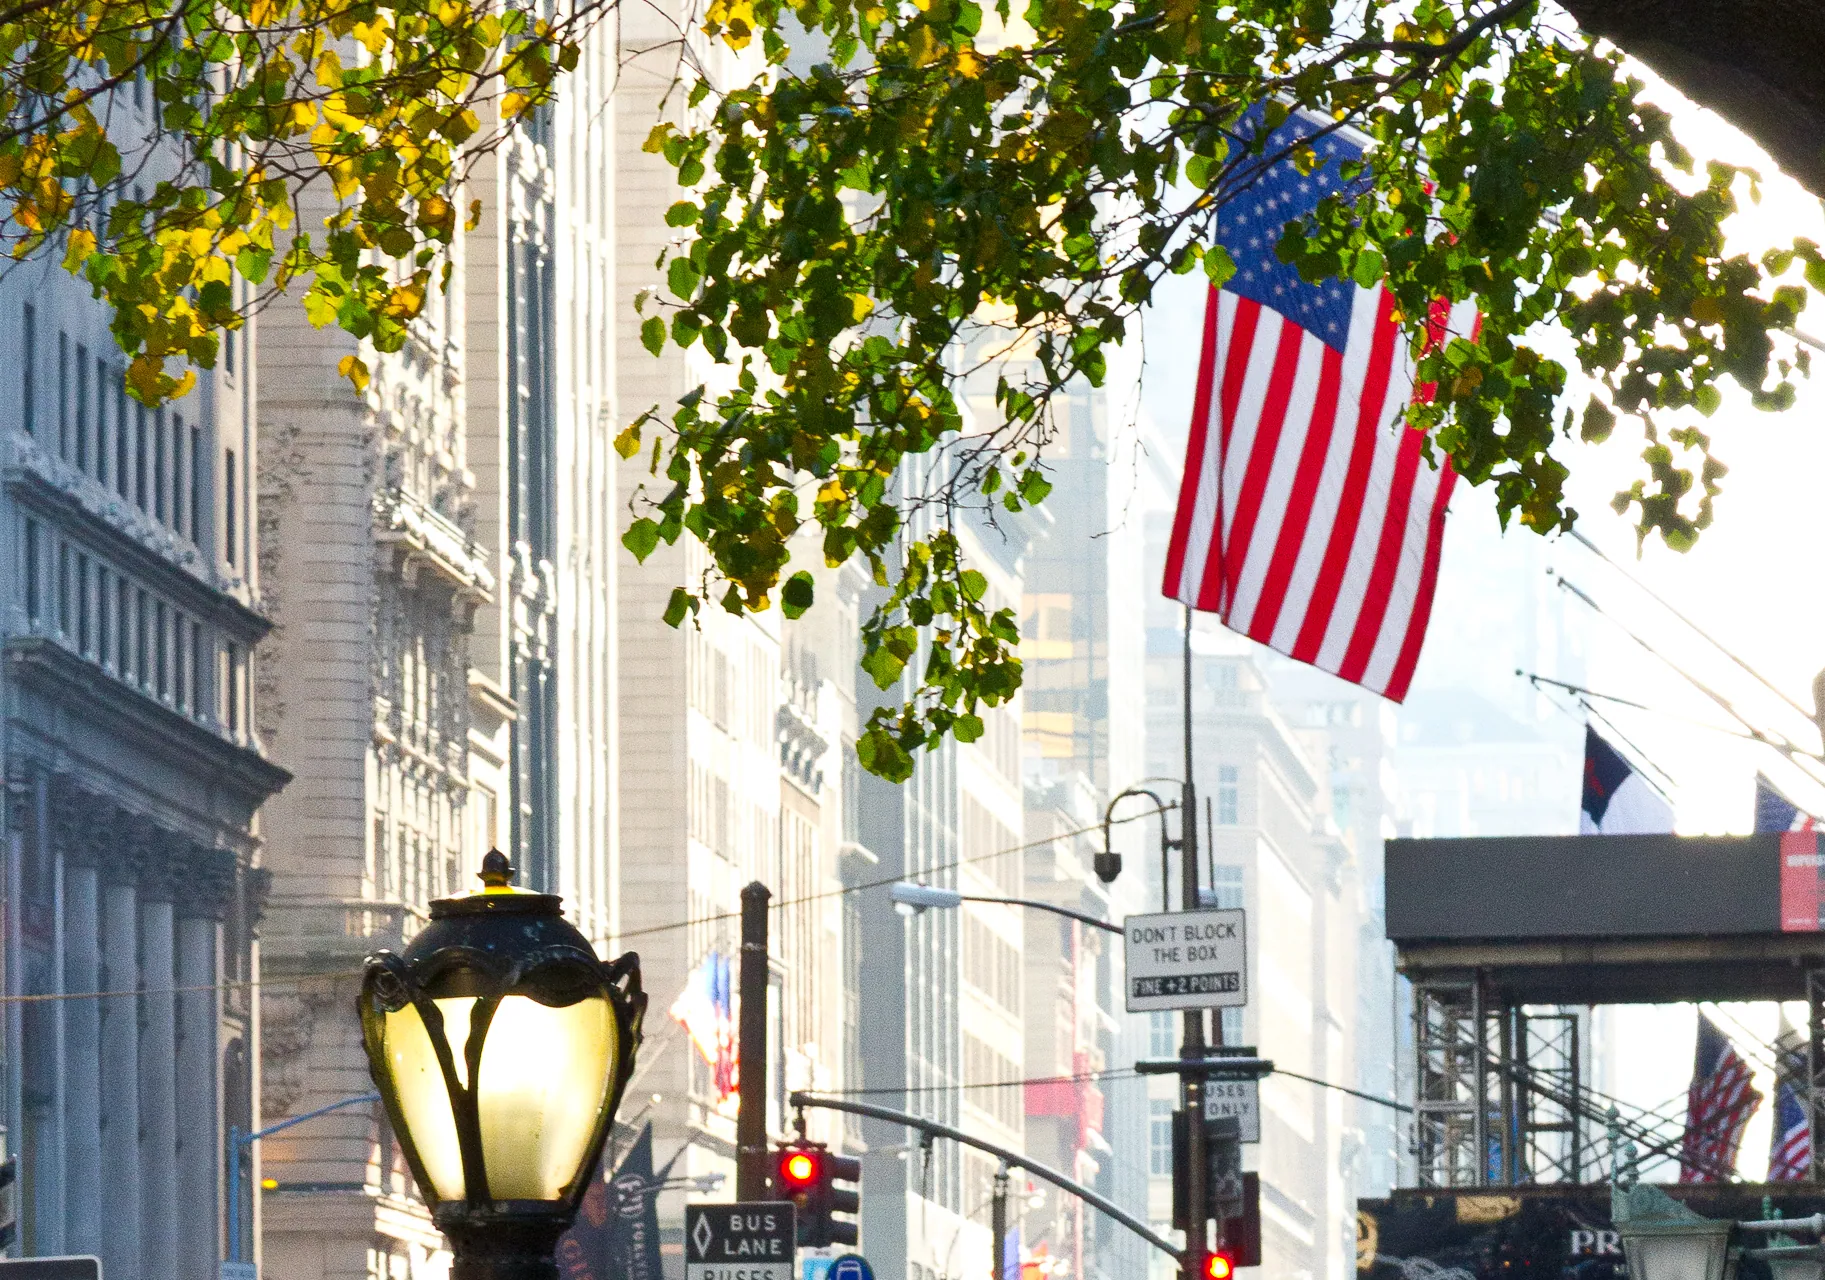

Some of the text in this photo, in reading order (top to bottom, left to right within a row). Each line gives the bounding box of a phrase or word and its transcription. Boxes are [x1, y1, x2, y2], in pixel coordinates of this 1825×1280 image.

[1184, 922, 1237, 941] BLOCK
[1153, 945, 1218, 962] THE BOX
[1205, 1084, 1245, 1098] USES
[1209, 1102, 1249, 1116] ONLY
[729, 1214, 777, 1232] BUS
[723, 1238, 782, 1255] LANE
